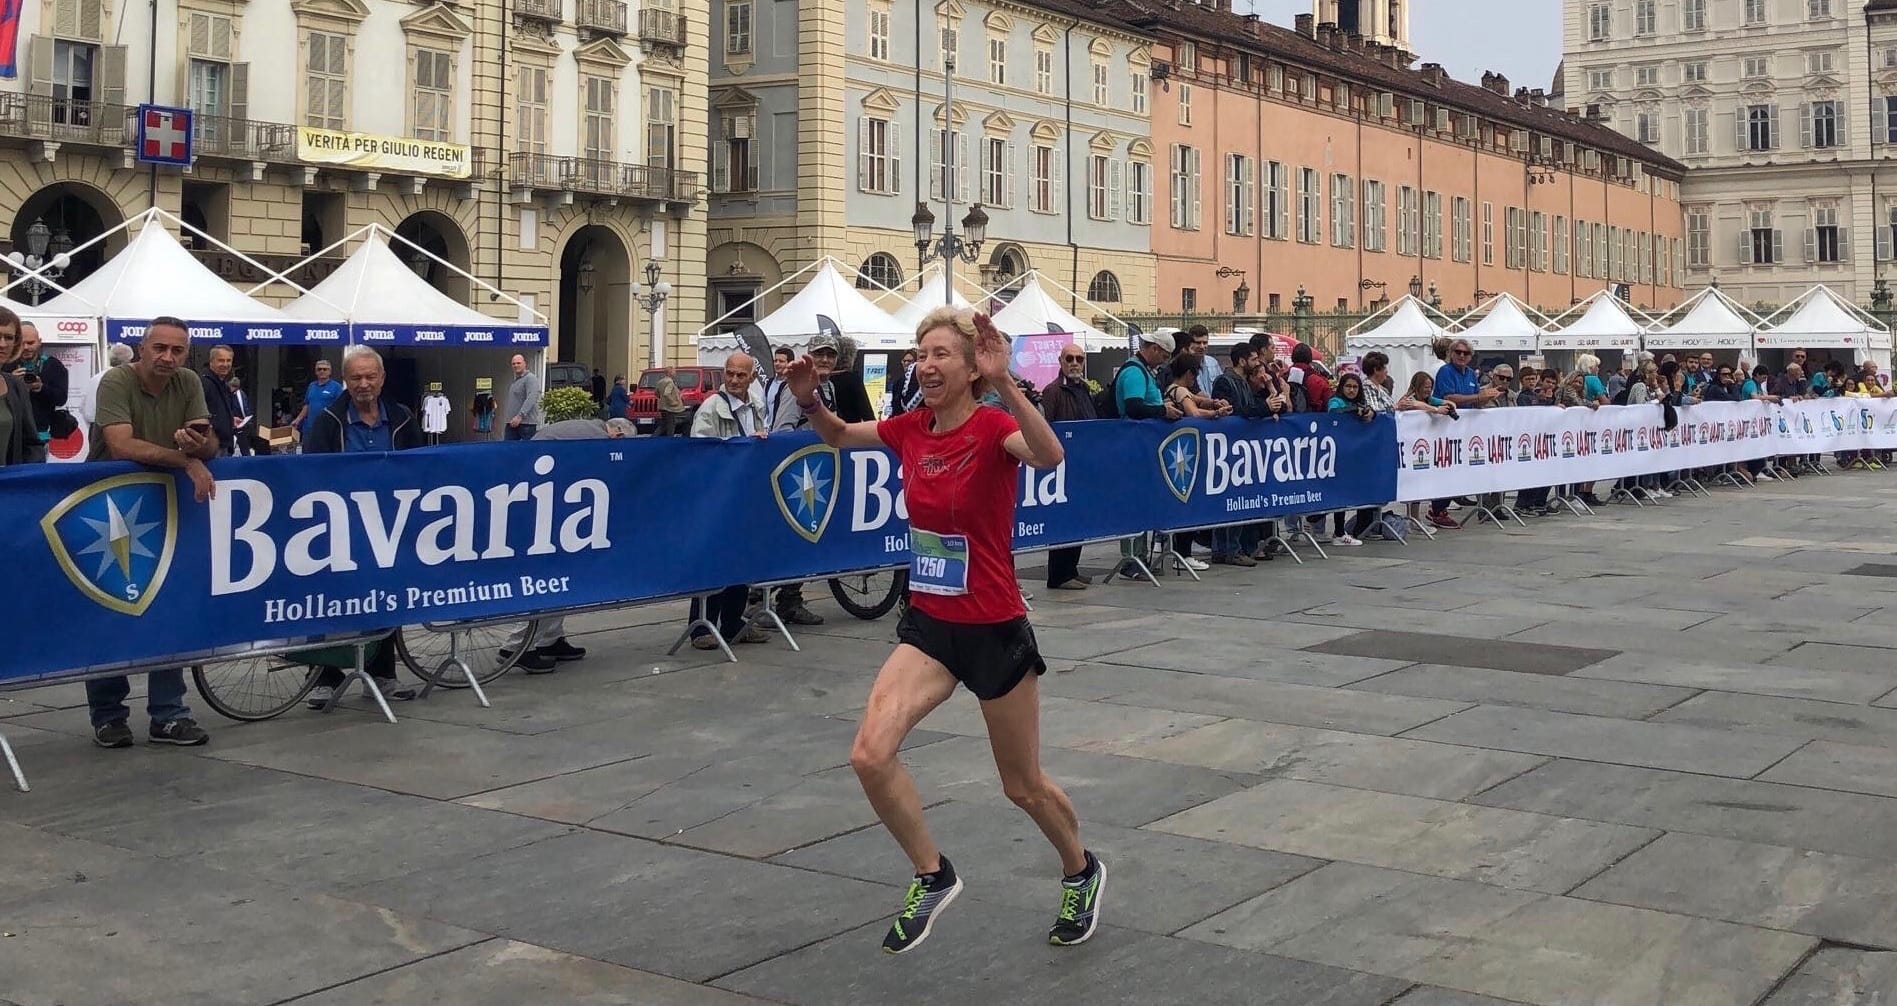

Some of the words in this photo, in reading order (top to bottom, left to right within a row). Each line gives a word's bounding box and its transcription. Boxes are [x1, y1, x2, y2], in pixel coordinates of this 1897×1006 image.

[306, 132, 350, 151] VERITÀ
[354, 138, 378, 153] PER
[382, 140, 419, 158] GIULIO
[423, 145, 464, 163] REGENI
[1205, 421, 1337, 495] Bavaria
[1226, 494, 1269, 511] Holland's
[1271, 492, 1306, 507] Premium
[1306, 490, 1322, 503] Beer
[209, 454, 611, 596] Bavaria
[1018, 521, 1045, 537] Beer
[916, 556, 947, 578] 1250
[126, 583, 139, 601] S
[263, 589, 398, 623] Holland's
[406, 581, 513, 609] Premium
[522, 574, 570, 597] Beer
